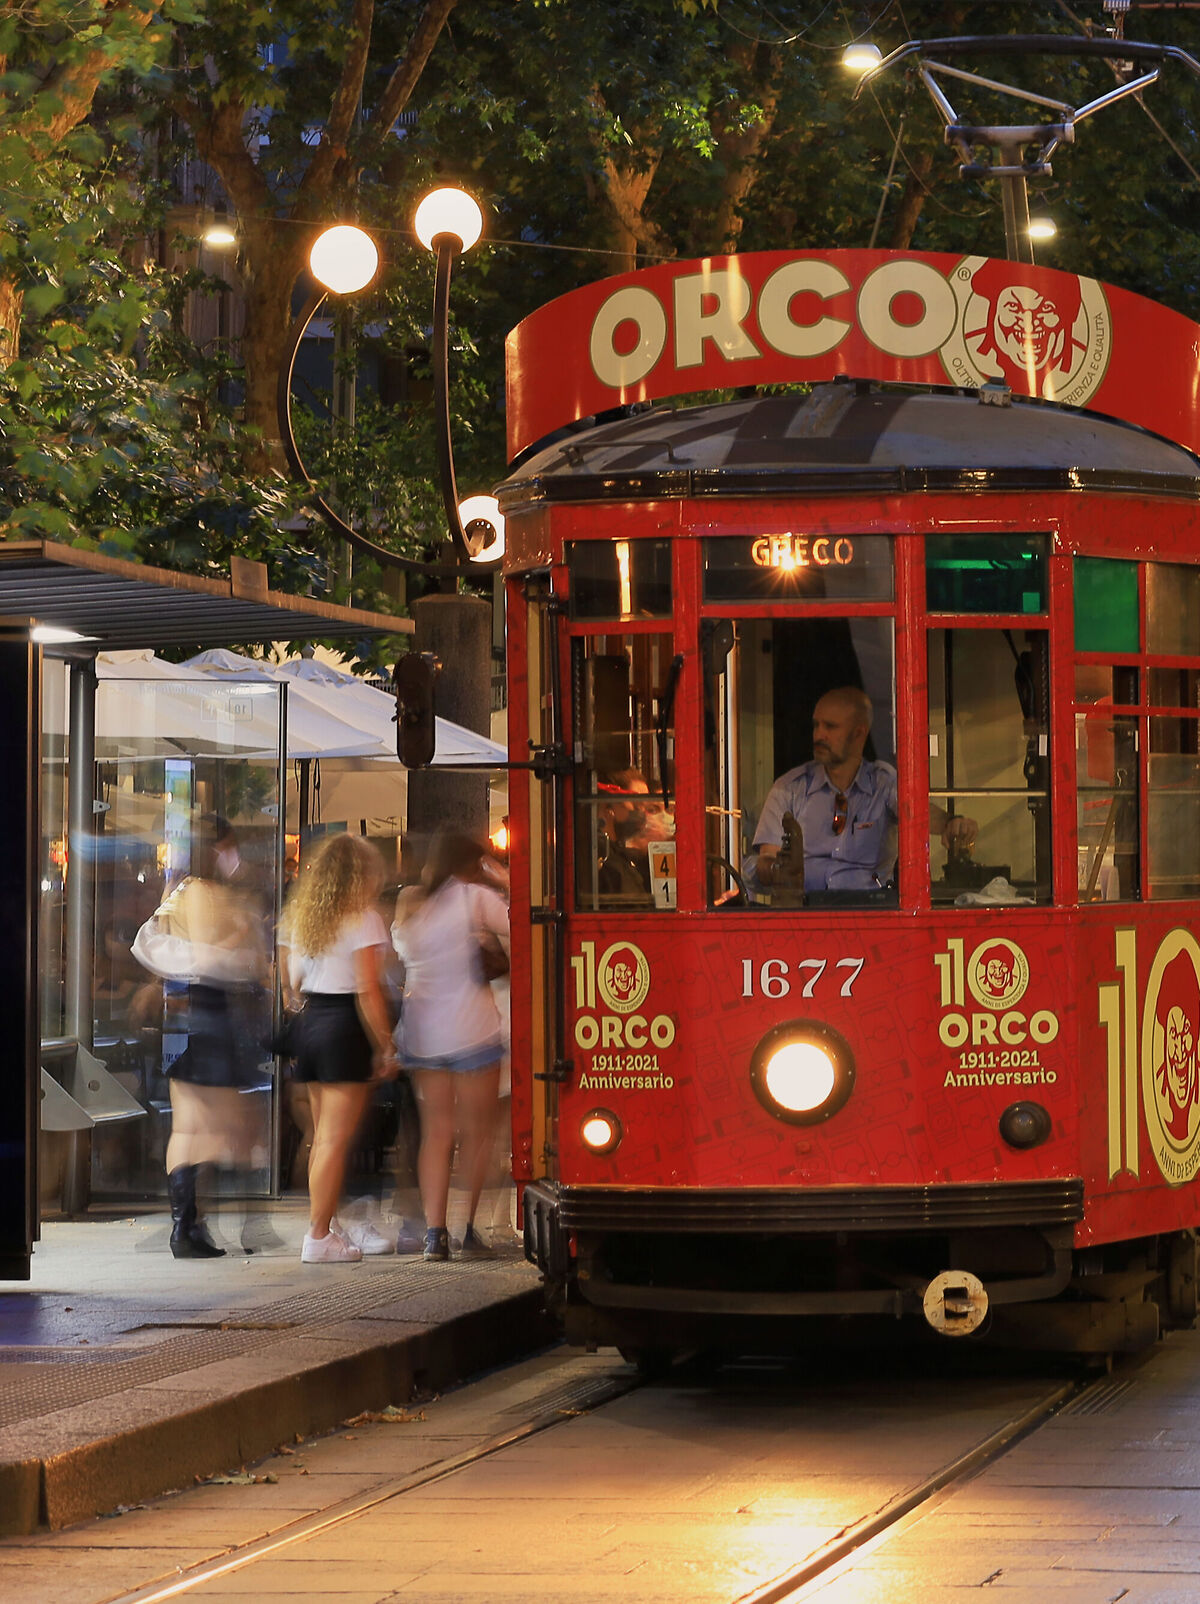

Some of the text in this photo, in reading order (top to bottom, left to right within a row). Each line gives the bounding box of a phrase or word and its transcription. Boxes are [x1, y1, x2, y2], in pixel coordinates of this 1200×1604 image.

[590, 258, 958, 389] ORCO
[751, 537, 854, 567] GRECO
[660, 855, 670, 876] 4
[662, 881, 670, 902] 1
[571, 941, 651, 1014] 110
[741, 957, 865, 998] 1677
[934, 937, 1030, 1010] 110
[575, 1014, 676, 1050] ORCO
[938, 1010, 1059, 1048] ORCO
[579, 1073, 675, 1089] Anniversario
[943, 1067, 1057, 1088] Anniversario
[1159, 1146, 1176, 1177] ANNI
